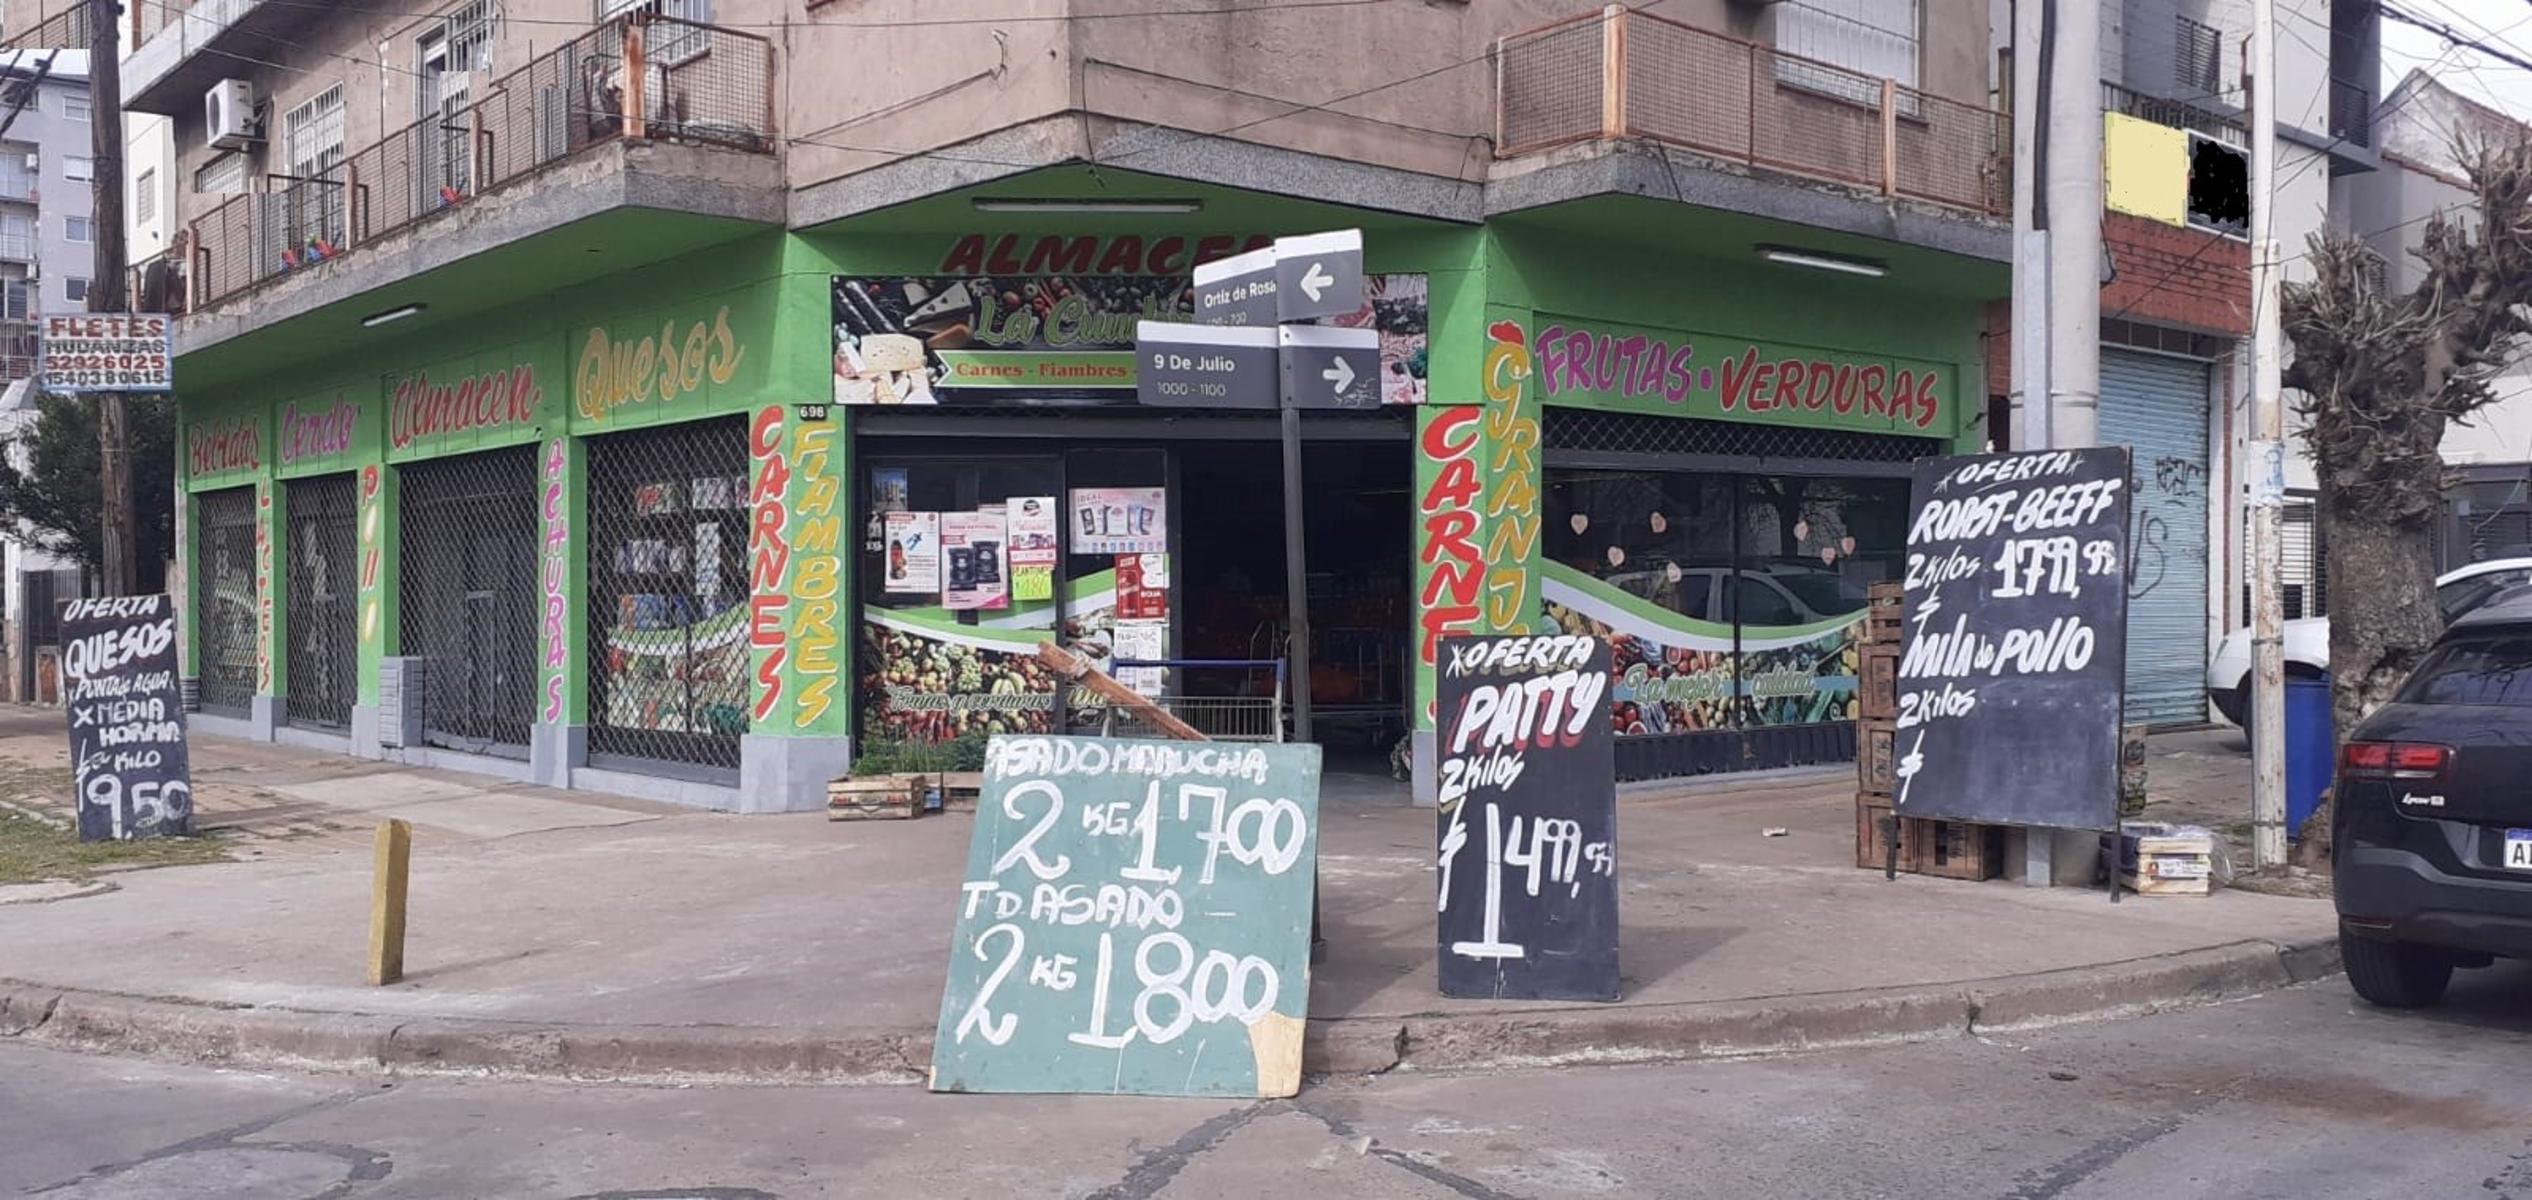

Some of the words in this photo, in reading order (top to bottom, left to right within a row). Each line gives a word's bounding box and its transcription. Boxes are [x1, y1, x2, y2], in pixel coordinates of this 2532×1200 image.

[941, 233, 1275, 274] ALMACE
[1204, 289, 1230, 308] Ortiz
[1233, 286, 1247, 301] de
[50, 317, 165, 338] FLETES
[973, 296, 1038, 346] La
[46, 339, 166, 354] MUDANZAS
[46, 355, 166, 370] 52926025
[575, 305, 745, 422] Quesos
[1154, 354, 1164, 370] 9
[1169, 354, 1192, 371] De
[1197, 355, 1236, 372] Julio
[46, 370, 166, 386] 1540380615
[956, 362, 1024, 378] Carnes
[1039, 361, 1127, 378] Fiambres
[1157, 381, 1188, 396] 1000
[1200, 382, 1226, 397] 1100
[1536, 324, 1693, 405] FRUTAS
[1718, 346, 1938, 429] VERDURAS
[389, 362, 541, 449] Almacen
[801, 406, 824, 419] 698
[282, 391, 357, 463] Cerdo
[1484, 330, 1543, 640] GRANJ
[1956, 451, 2072, 485] OFERTA
[1906, 478, 2123, 545] ROAST-BEEFF
[543, 436, 567, 725] ACHURAS
[749, 404, 790, 721] CARNES
[793, 421, 842, 728] FIAMBRES
[1420, 405, 1487, 725] CARNE
[64, 597, 160, 622] OFERTA
[65, 618, 173, 679] QUESOS
[1464, 635, 1595, 675] OFERTA
[75, 675, 121, 701] PUNTA
[133, 669, 170, 696] AGUA
[97, 697, 165, 724] MEDIA
[1450, 669, 1608, 755] PATTY
[99, 720, 181, 748] HORMA
[986, 738, 1109, 779] ASADO
[992, 779, 1071, 880] 2
[1081, 801, 1131, 836] KG
[1120, 778, 1307, 885] 1700
[1030, 882, 1184, 930] ASADO
[957, 923, 1025, 1046] 2
[1029, 953, 1078, 991] KG
[1067, 931, 1280, 1048] 1800
